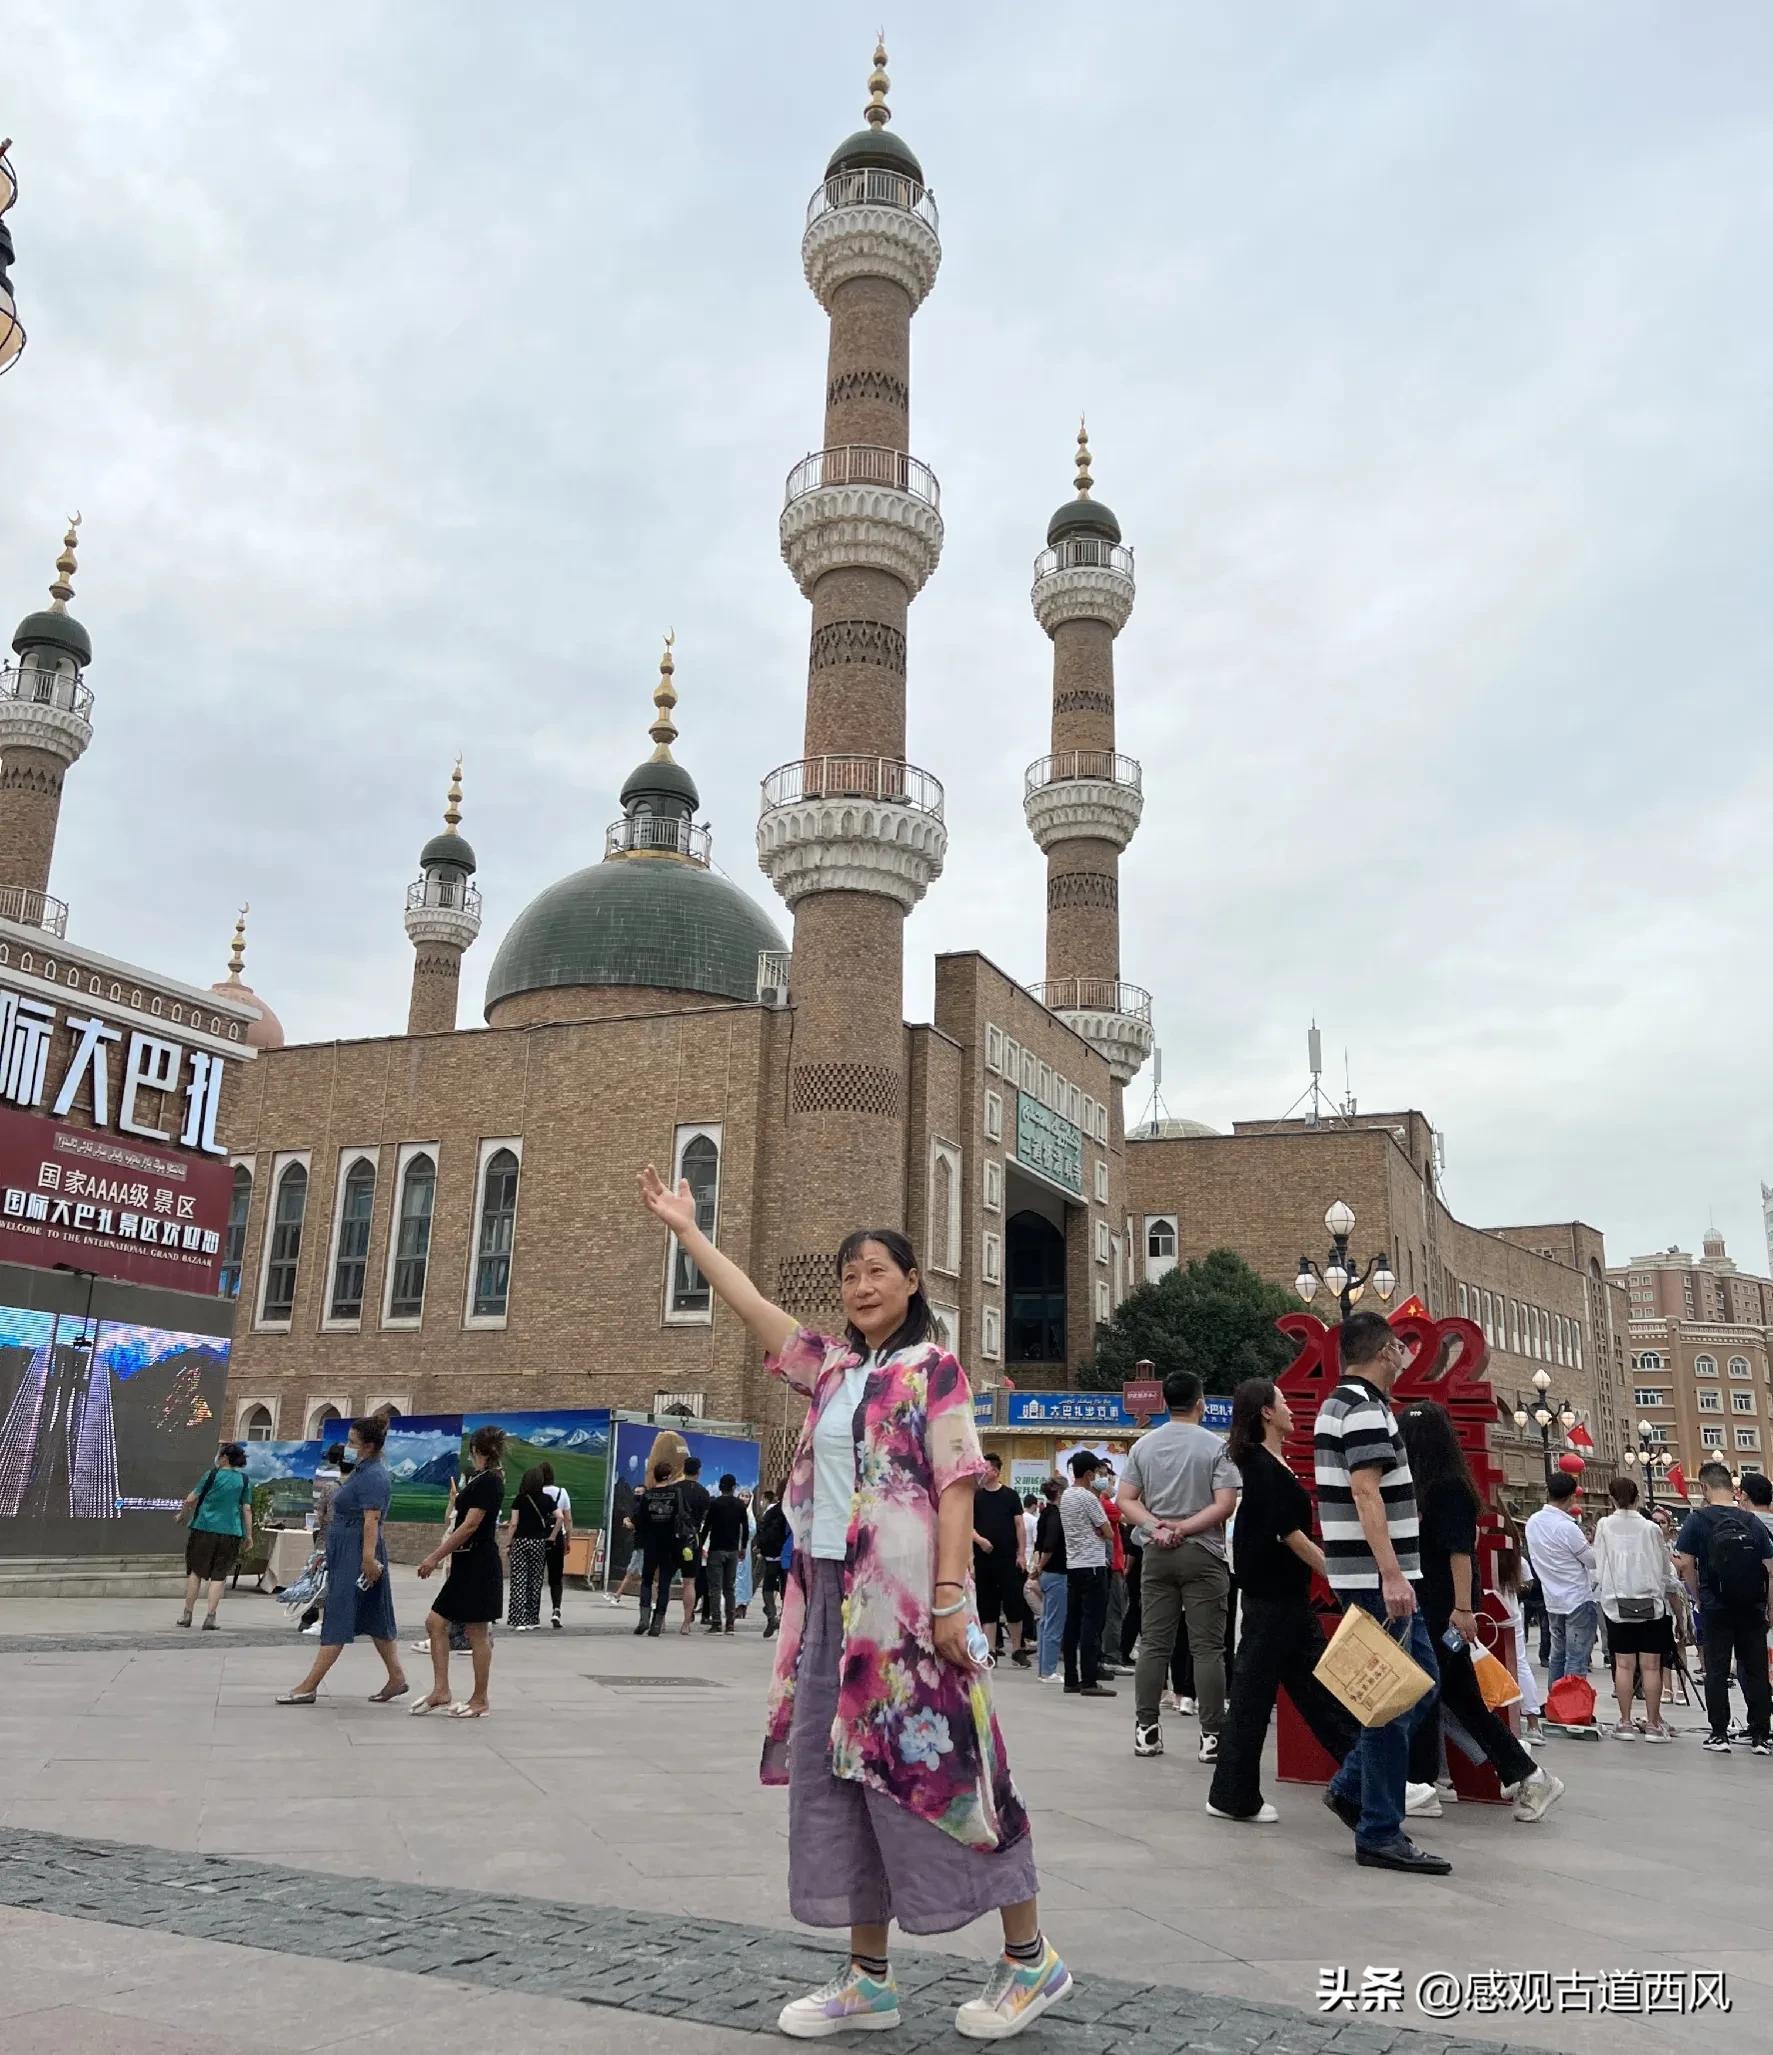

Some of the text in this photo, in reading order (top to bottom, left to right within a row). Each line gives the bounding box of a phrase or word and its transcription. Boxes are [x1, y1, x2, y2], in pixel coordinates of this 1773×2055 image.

[38, 1161, 197, 1219] 国家AAAA级景区
[3, 1188, 220, 1254] 国际大巴扎景区欢迎您
[47, 1229, 60, 1239] TO
[62, 1230, 81, 1242] THE
[83, 1236, 149, 1256] INTERNATIONAL
[151, 1249, 180, 1261] GRAND
[182, 1254, 213, 1267] BAZAAR
